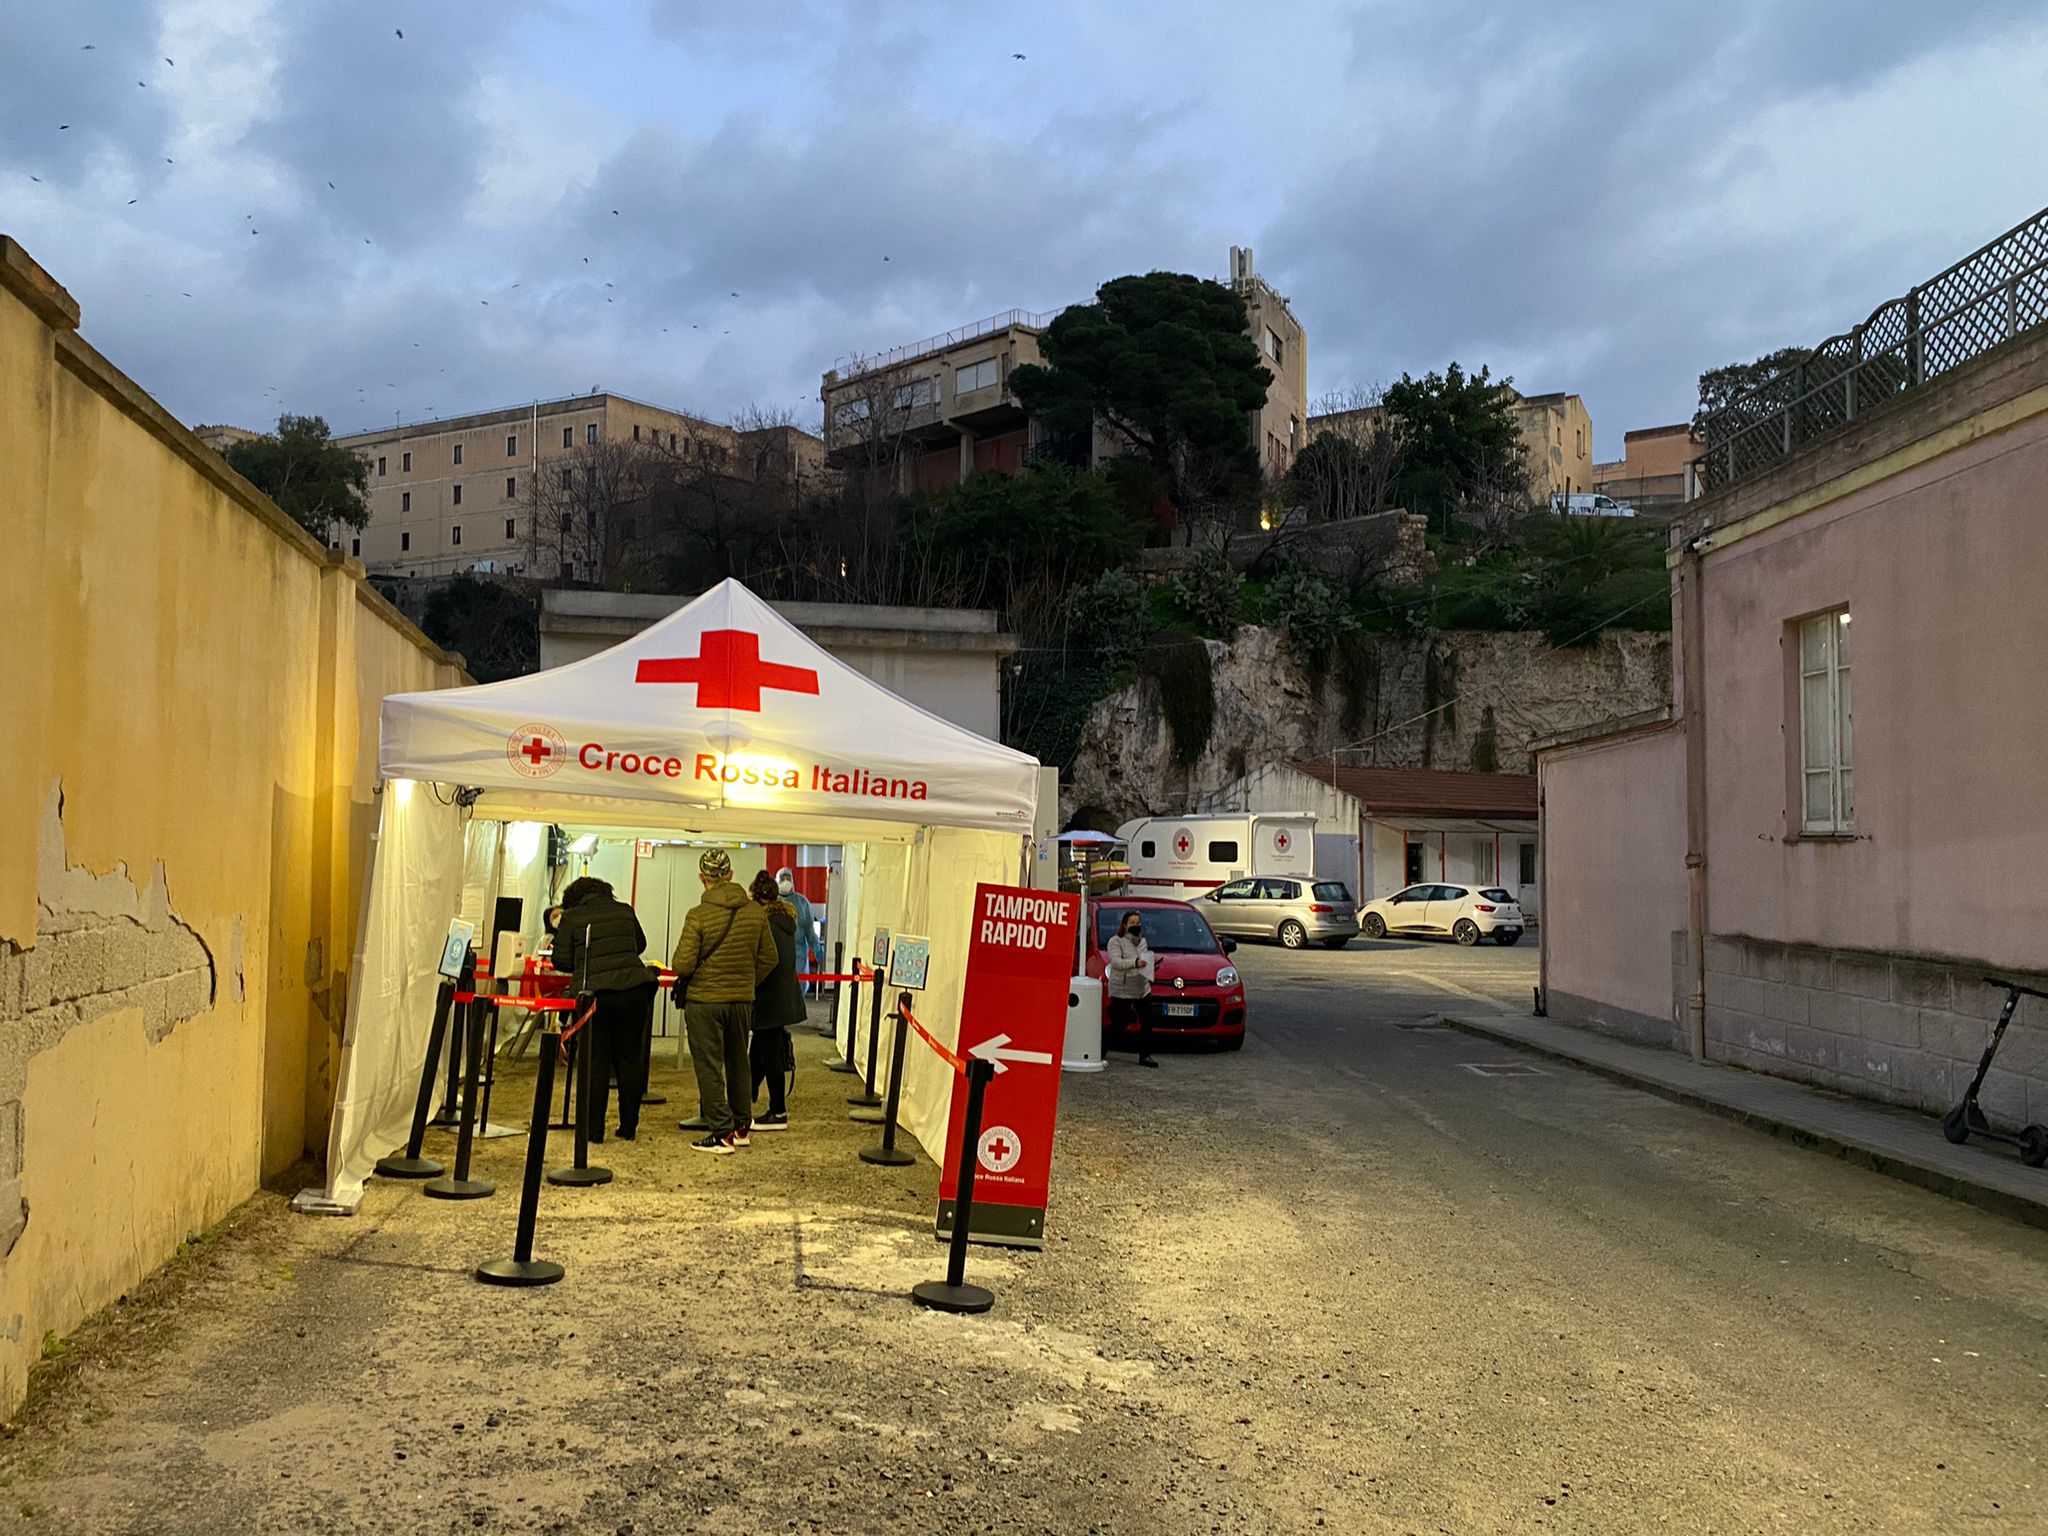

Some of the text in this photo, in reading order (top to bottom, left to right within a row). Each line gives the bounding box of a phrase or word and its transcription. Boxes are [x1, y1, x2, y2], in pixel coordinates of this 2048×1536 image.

[578, 743, 682, 778] Croce
[694, 753, 800, 789] Rossa
[811, 765, 928, 800] Italiana
[985, 893, 1070, 926] TAMPONE
[981, 919, 1047, 950] RAPIDO
